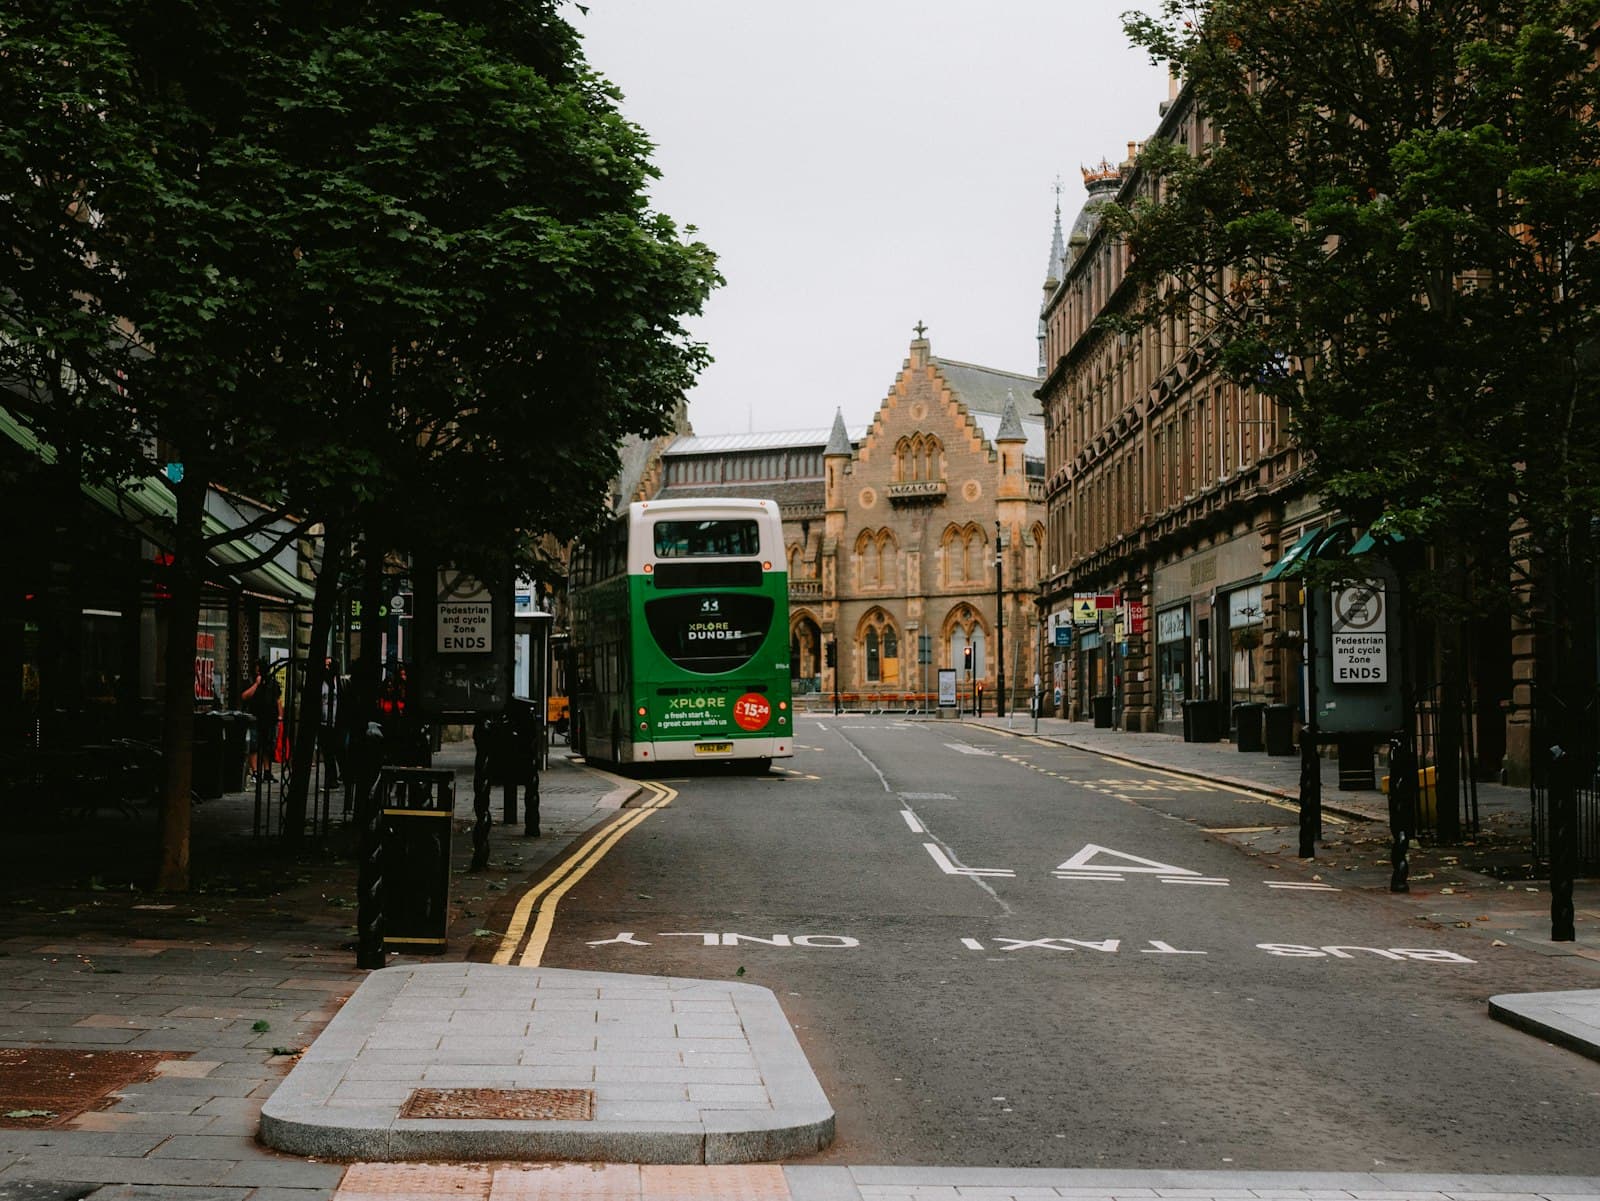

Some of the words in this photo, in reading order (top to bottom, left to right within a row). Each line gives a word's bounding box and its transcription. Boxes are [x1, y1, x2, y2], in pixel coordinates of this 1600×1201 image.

[440, 606, 489, 615] Pedestrian
[443, 616, 460, 624] and
[462, 615, 487, 625] cycle
[453, 625, 476, 633] Zone
[688, 622, 729, 631] XPLORE
[688, 630, 742, 640] DUNDEE
[444, 637, 486, 649] ENDS
[1335, 636, 1384, 645] Pedestrian
[1338, 646, 1355, 654] and
[1357, 646, 1381, 656] cycle
[1348, 655, 1371, 664] Zone
[1340, 667, 1381, 679] ENDS
[669, 697, 726, 709] XPLORE
[670, 711, 687, 719] fresh
[663, 720, 682, 729] great
[703, 718, 718, 726] with
[585, 932, 860, 948] ONLY
[960, 937, 1208, 955] TAXI
[1256, 943, 1478, 964] BUS
